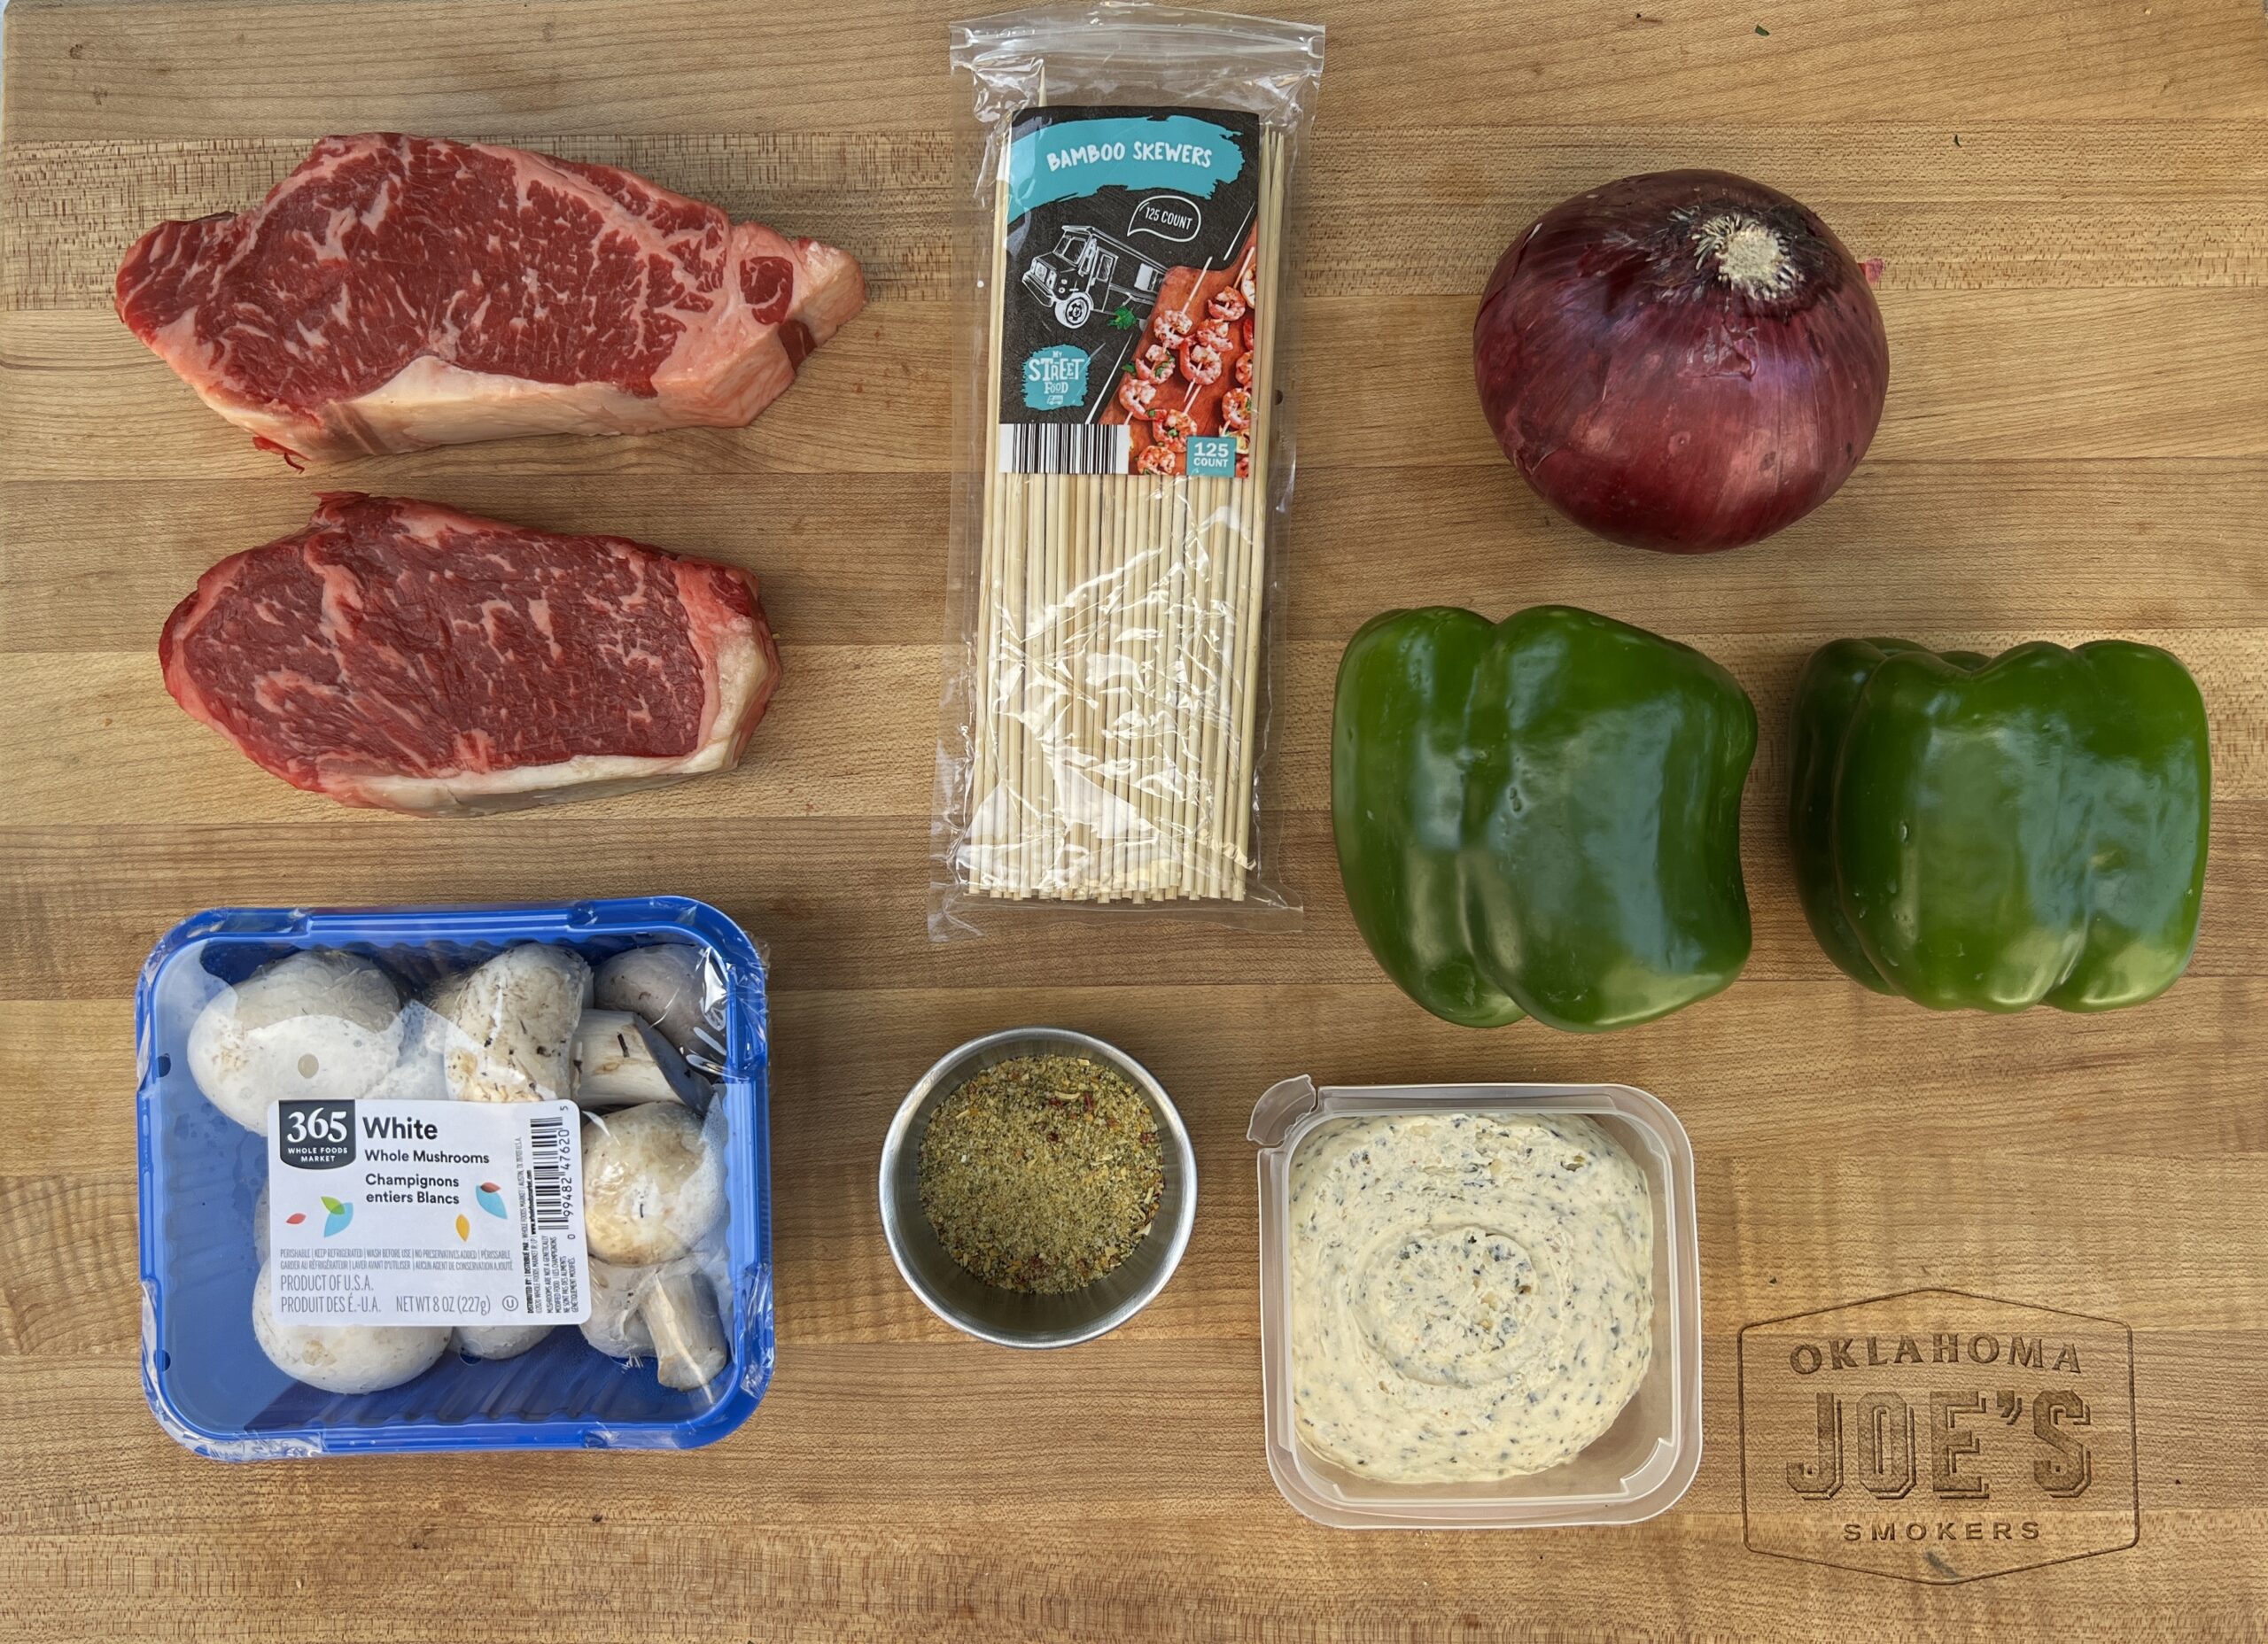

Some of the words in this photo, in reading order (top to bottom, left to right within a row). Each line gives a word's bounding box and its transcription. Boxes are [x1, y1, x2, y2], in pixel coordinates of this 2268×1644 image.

[1046, 142, 1125, 172] BAMBOO
[1133, 141, 1212, 168] SKEWERS
[1145, 206, 1159, 221] 125
[1161, 211, 1192, 230] COUNT
[1028, 358, 1085, 381] STREET
[1044, 381, 1069, 394] FOOD
[1193, 443, 1229, 457] 125
[1193, 457, 1228, 468] COUNT
[286, 1107, 348, 1144] 365
[362, 1116, 439, 1140] White
[300, 1154, 335, 1163] MARKET
[365, 1150, 409, 1162] Whole
[413, 1150, 490, 1164] Mushrooms
[558, 1129, 570, 1169] 47620
[365, 1173, 459, 1190] Champignons
[366, 1191, 413, 1203] entiers
[416, 1191, 460, 1205] Blancs
[561, 1177, 573, 1216] 99482
[281, 1275, 327, 1291] PRODUCT
[330, 1275, 342, 1291] OF
[344, 1275, 374, 1291] U.S.A.
[281, 1296, 324, 1313] PRODUIT
[327, 1296, 346, 1312] DES
[396, 1296, 414, 1312] NET
[416, 1296, 431, 1312] WT
[432, 1296, 439, 1312] 8
[443, 1296, 454, 1312] OZ
[457, 1295, 491, 1315] (227g)
[1790, 1332, 2081, 1375] OKLAHOMA
[1786, 1389, 2092, 1501] JOE'S
[1843, 1522, 2040, 1541] SMOKERS
